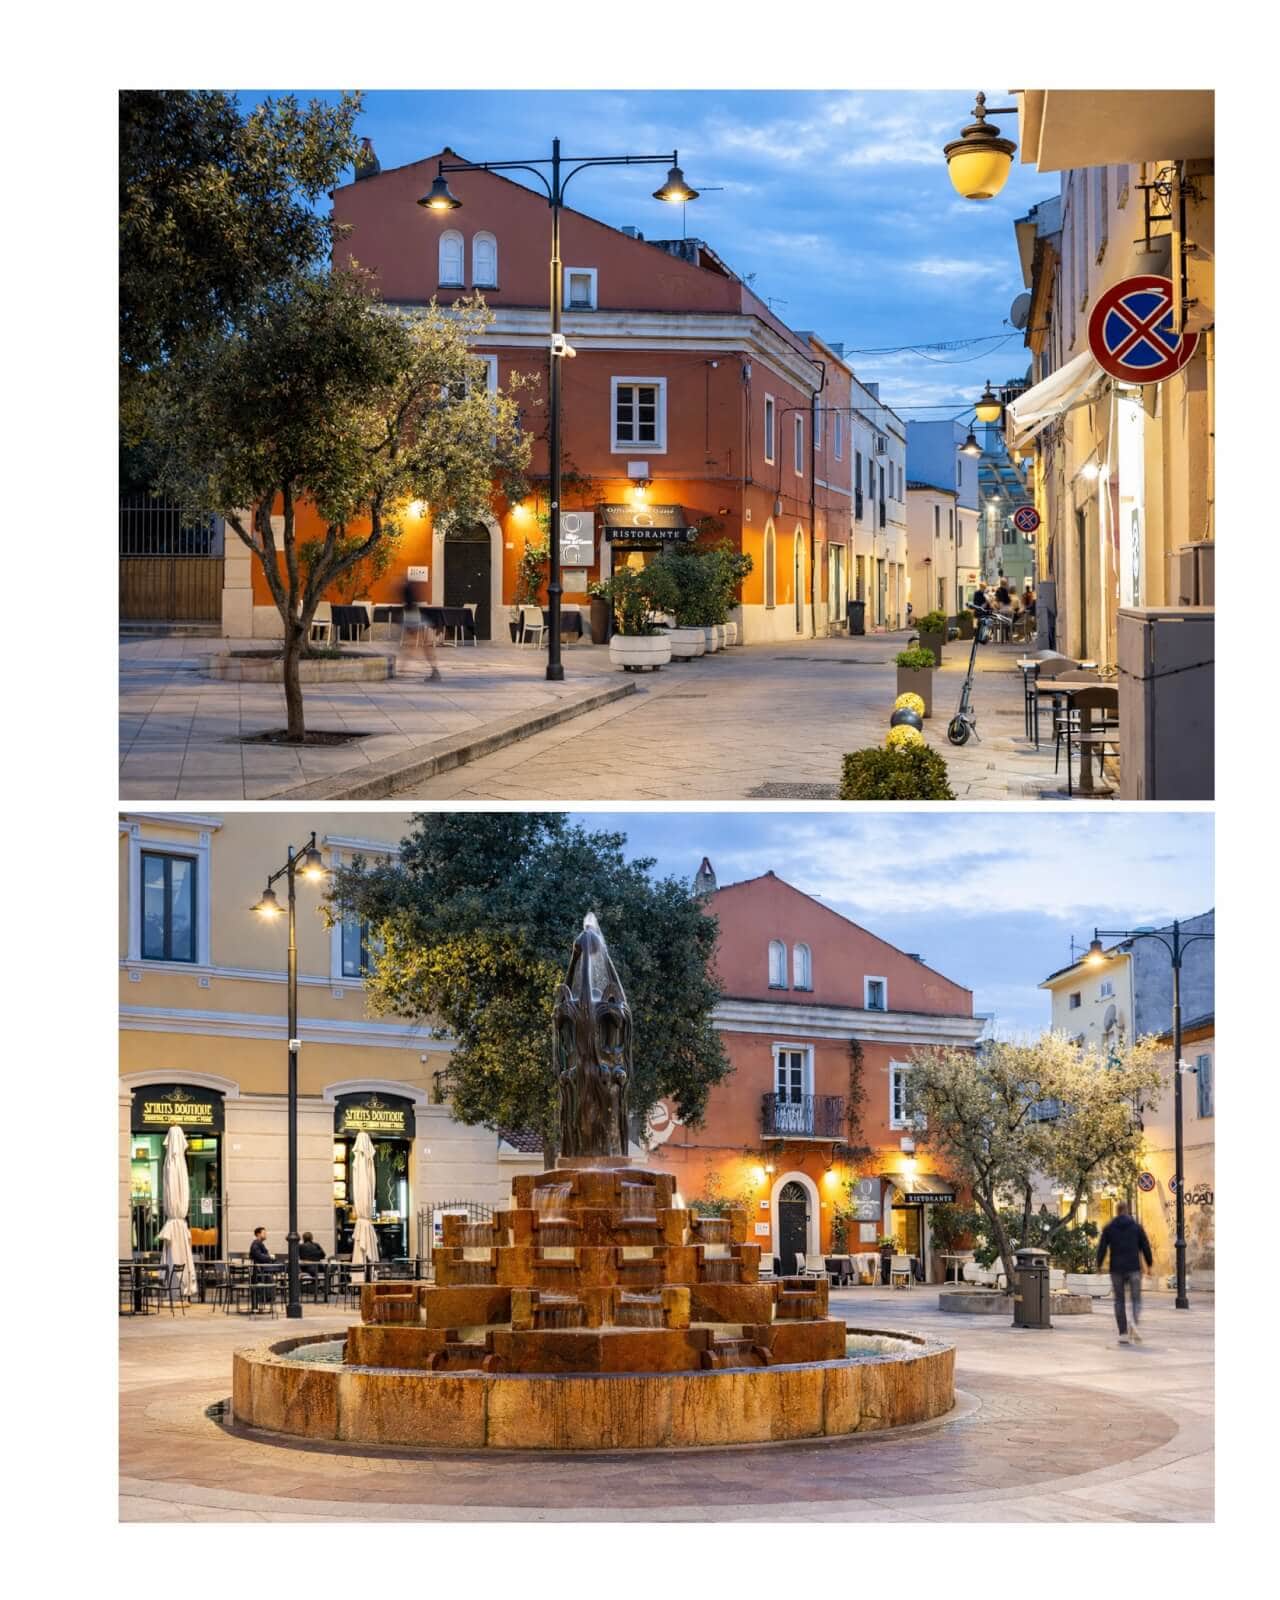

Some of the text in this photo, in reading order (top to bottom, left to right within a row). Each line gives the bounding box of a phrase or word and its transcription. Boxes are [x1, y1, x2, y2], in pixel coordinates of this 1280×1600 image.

[144, 1103, 212, 1115] SPIRITS BOUTIQUE
[345, 1109, 404, 1121] SPIRITS BOUTIQUE
